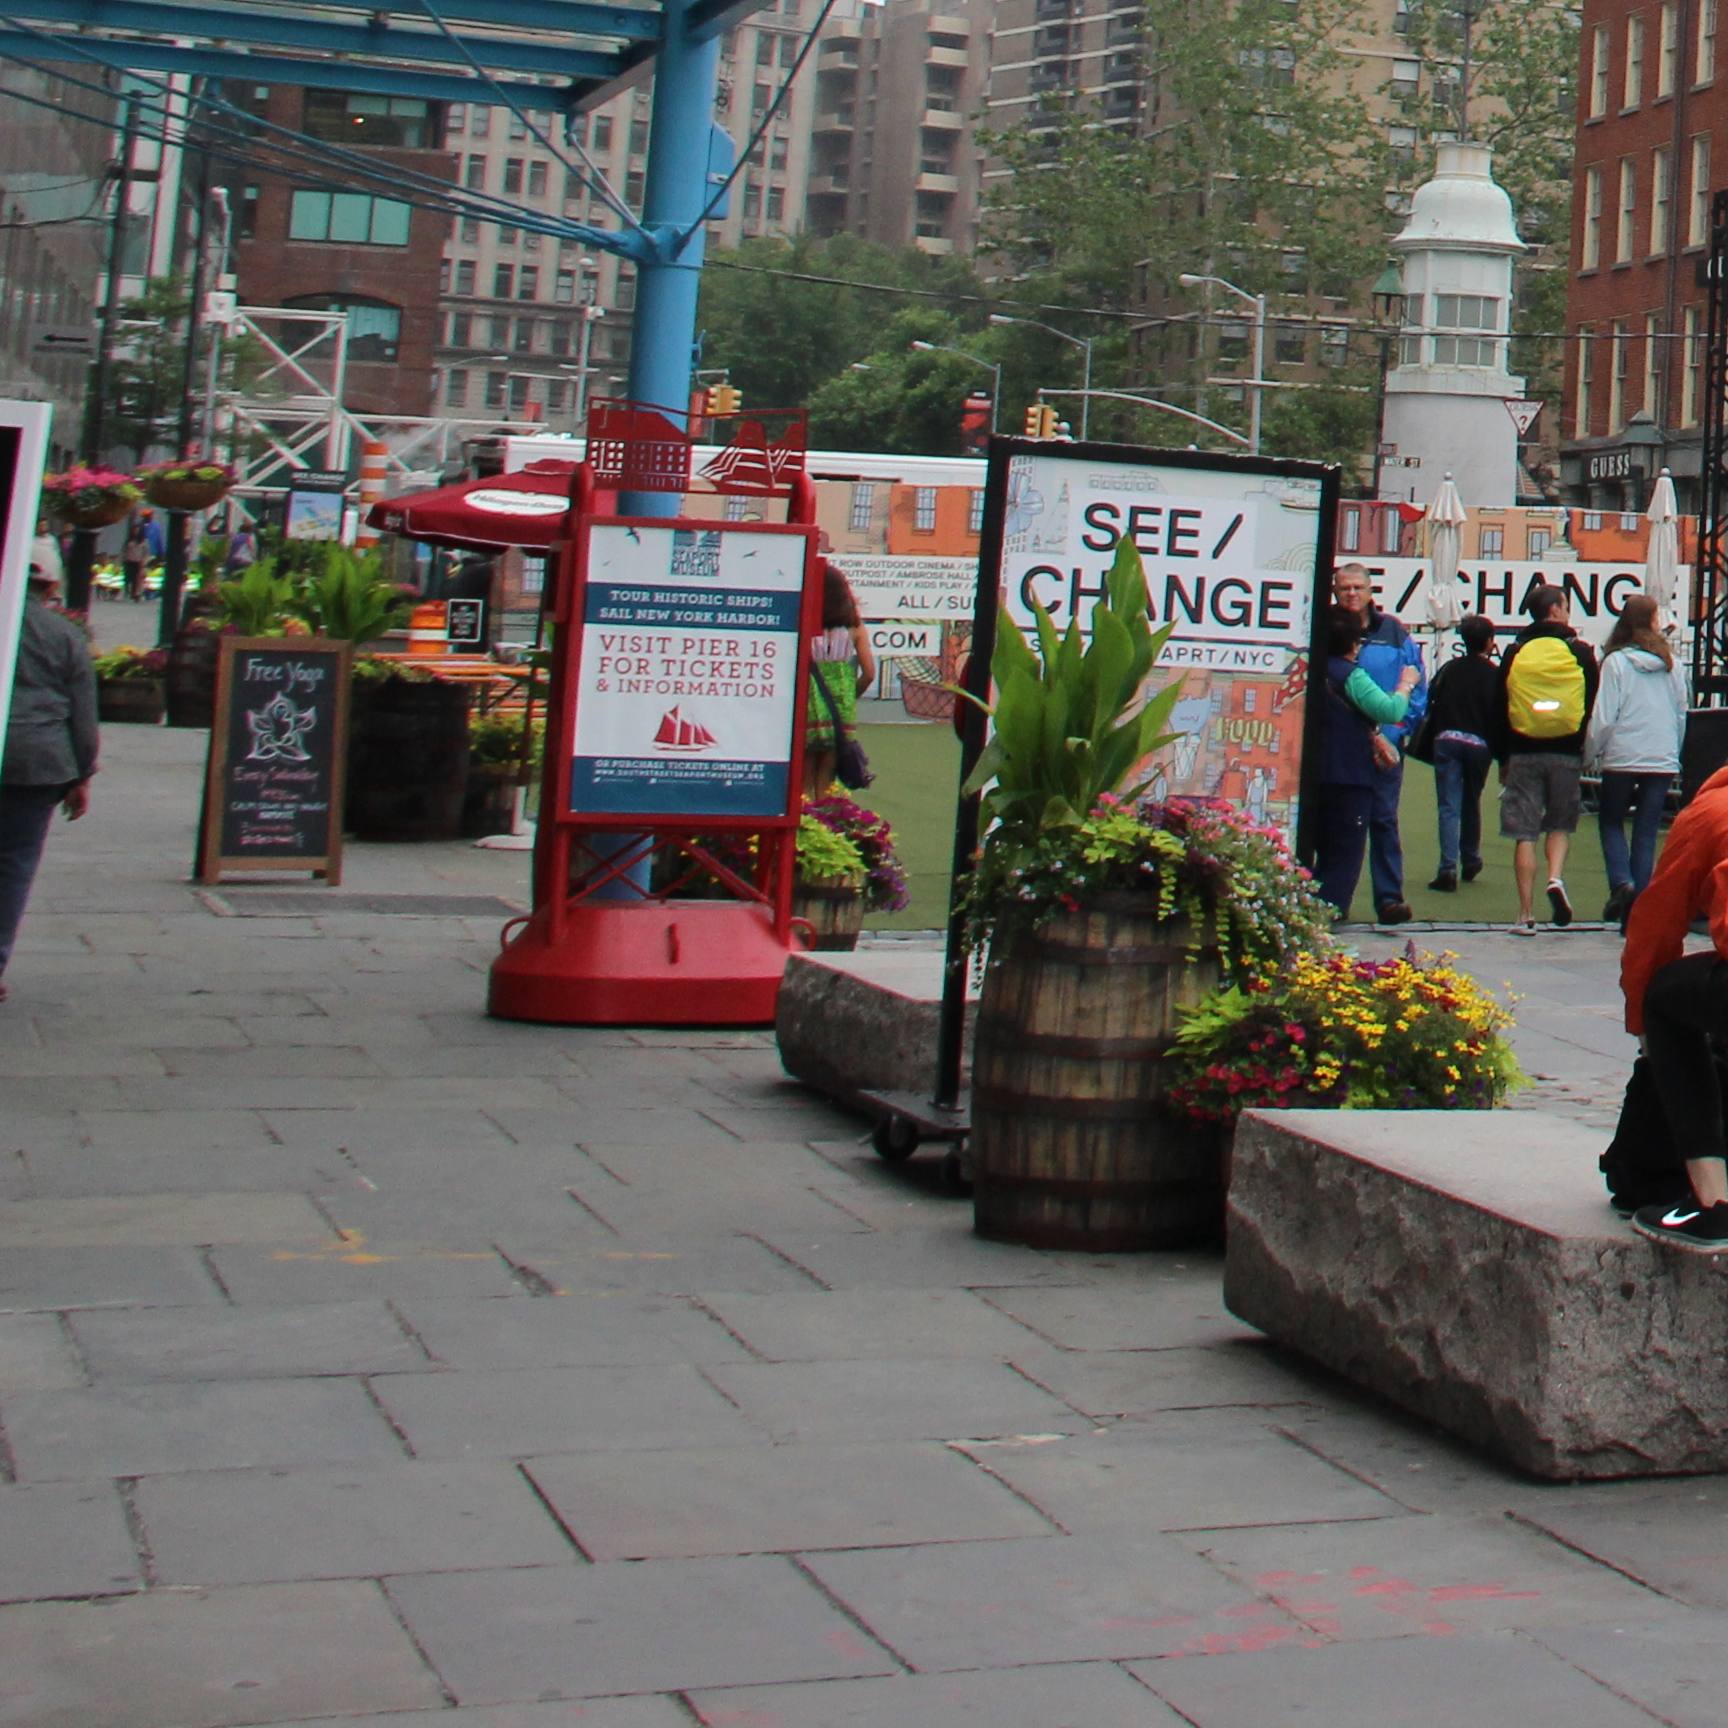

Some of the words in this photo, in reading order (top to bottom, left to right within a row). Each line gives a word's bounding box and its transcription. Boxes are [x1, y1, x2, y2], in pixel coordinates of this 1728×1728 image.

[1590, 453, 1631, 479] GUESS
[610, 590, 650, 603] TOUR
[653, 592, 723, 606] HISTORIC
[727, 595, 773, 608] SHIPS!
[898, 595, 930, 609] ALL
[1019, 564, 1294, 630] CHNGE
[599, 607, 633, 620] SAIL
[636, 609, 671, 621] NEW
[674, 611, 714, 623] YORK
[716, 613, 781, 626] HARBOR!
[599, 634, 672, 654] VISIT
[682, 637, 740, 657] PIER
[750, 640, 776, 658] 16
[244, 657, 284, 682] Free
[286, 660, 326, 694] Yoga
[598, 656, 650, 674] FOR
[661, 658, 774, 680] TICKETS
[595, 678, 609, 693] &
[618, 679, 775, 698] INFORMATION
